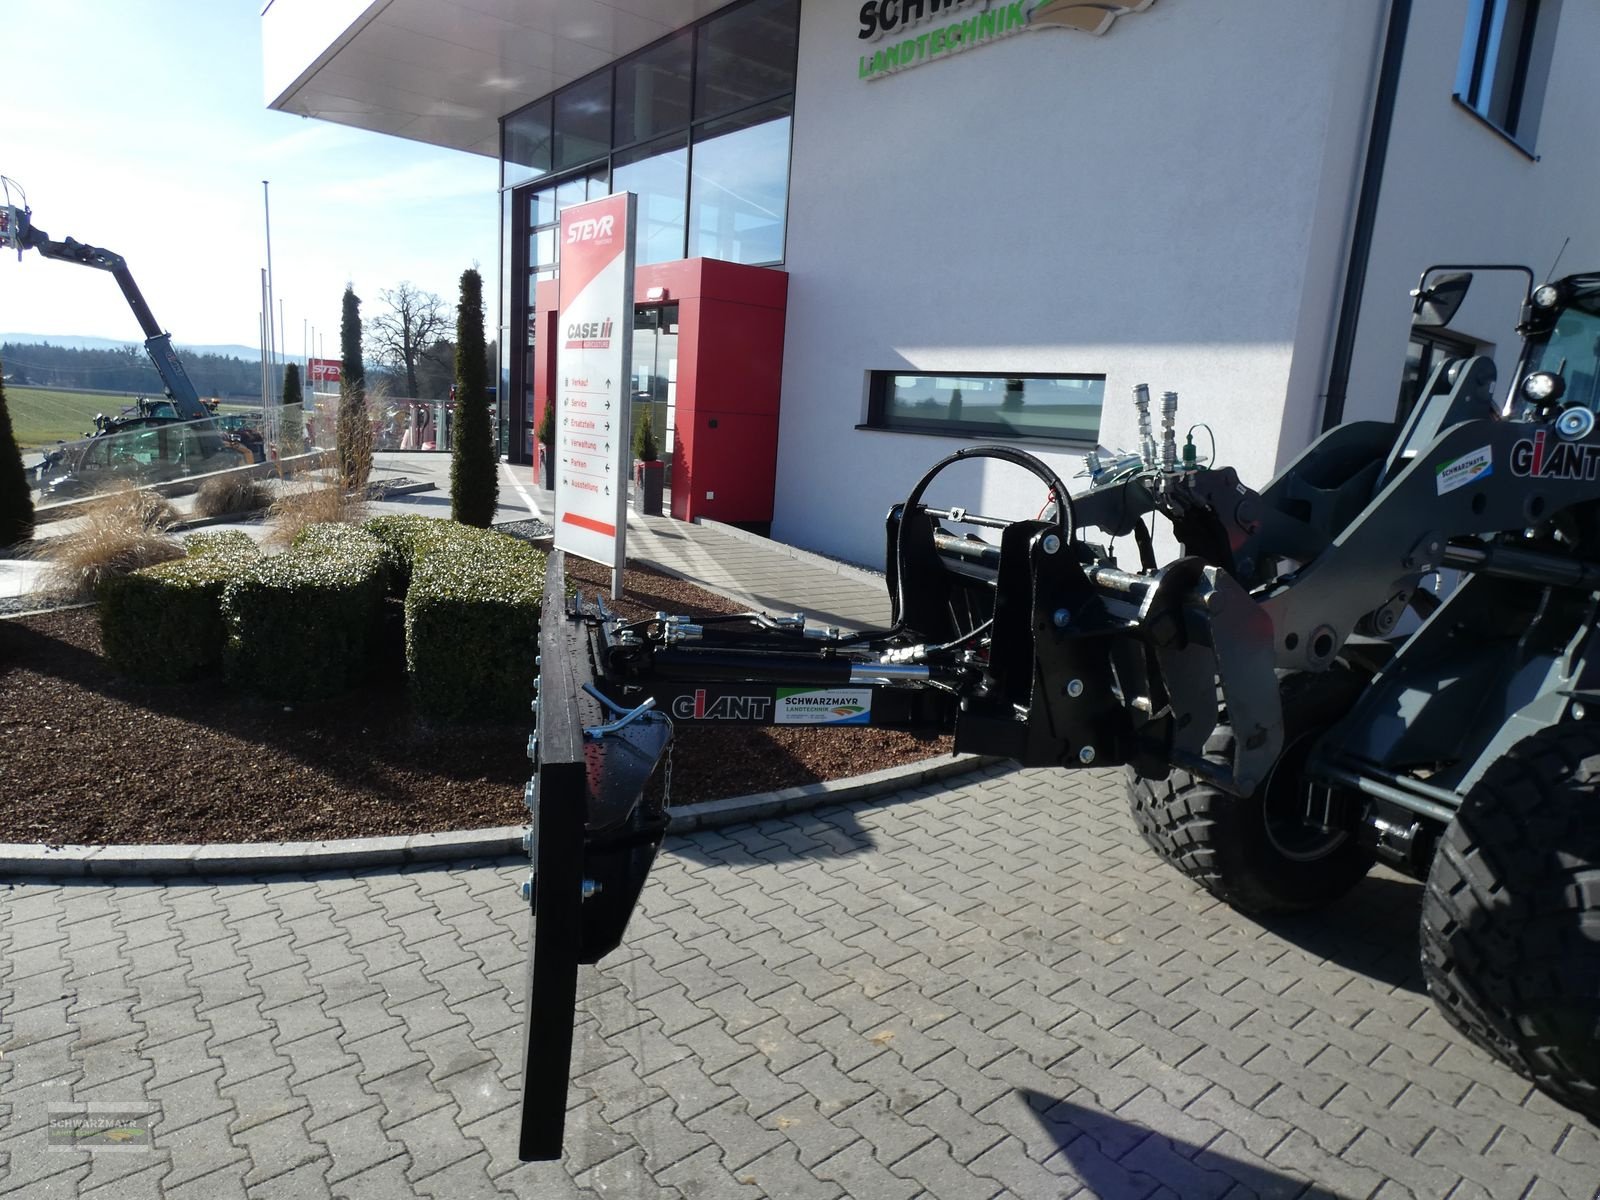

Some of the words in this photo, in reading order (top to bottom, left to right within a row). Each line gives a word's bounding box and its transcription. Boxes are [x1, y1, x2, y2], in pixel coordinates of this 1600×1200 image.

[859, 0, 1025, 80] LANDTECHNIK
[566, 215, 614, 244] STEYR
[568, 322, 598, 338] CASE
[312, 364, 342, 375] STEY
[572, 377, 588, 386] Verkauf
[571, 398, 588, 408] Service
[571, 418, 595, 429] Ersatzteile
[571, 440, 597, 450] Verwaltung
[570, 458, 587, 469] Parken
[1442, 455, 1484, 478] SCHWARZMAYR
[571, 479, 598, 492] Ausstellung
[785, 697, 858, 706] SCHWARZMAYR
